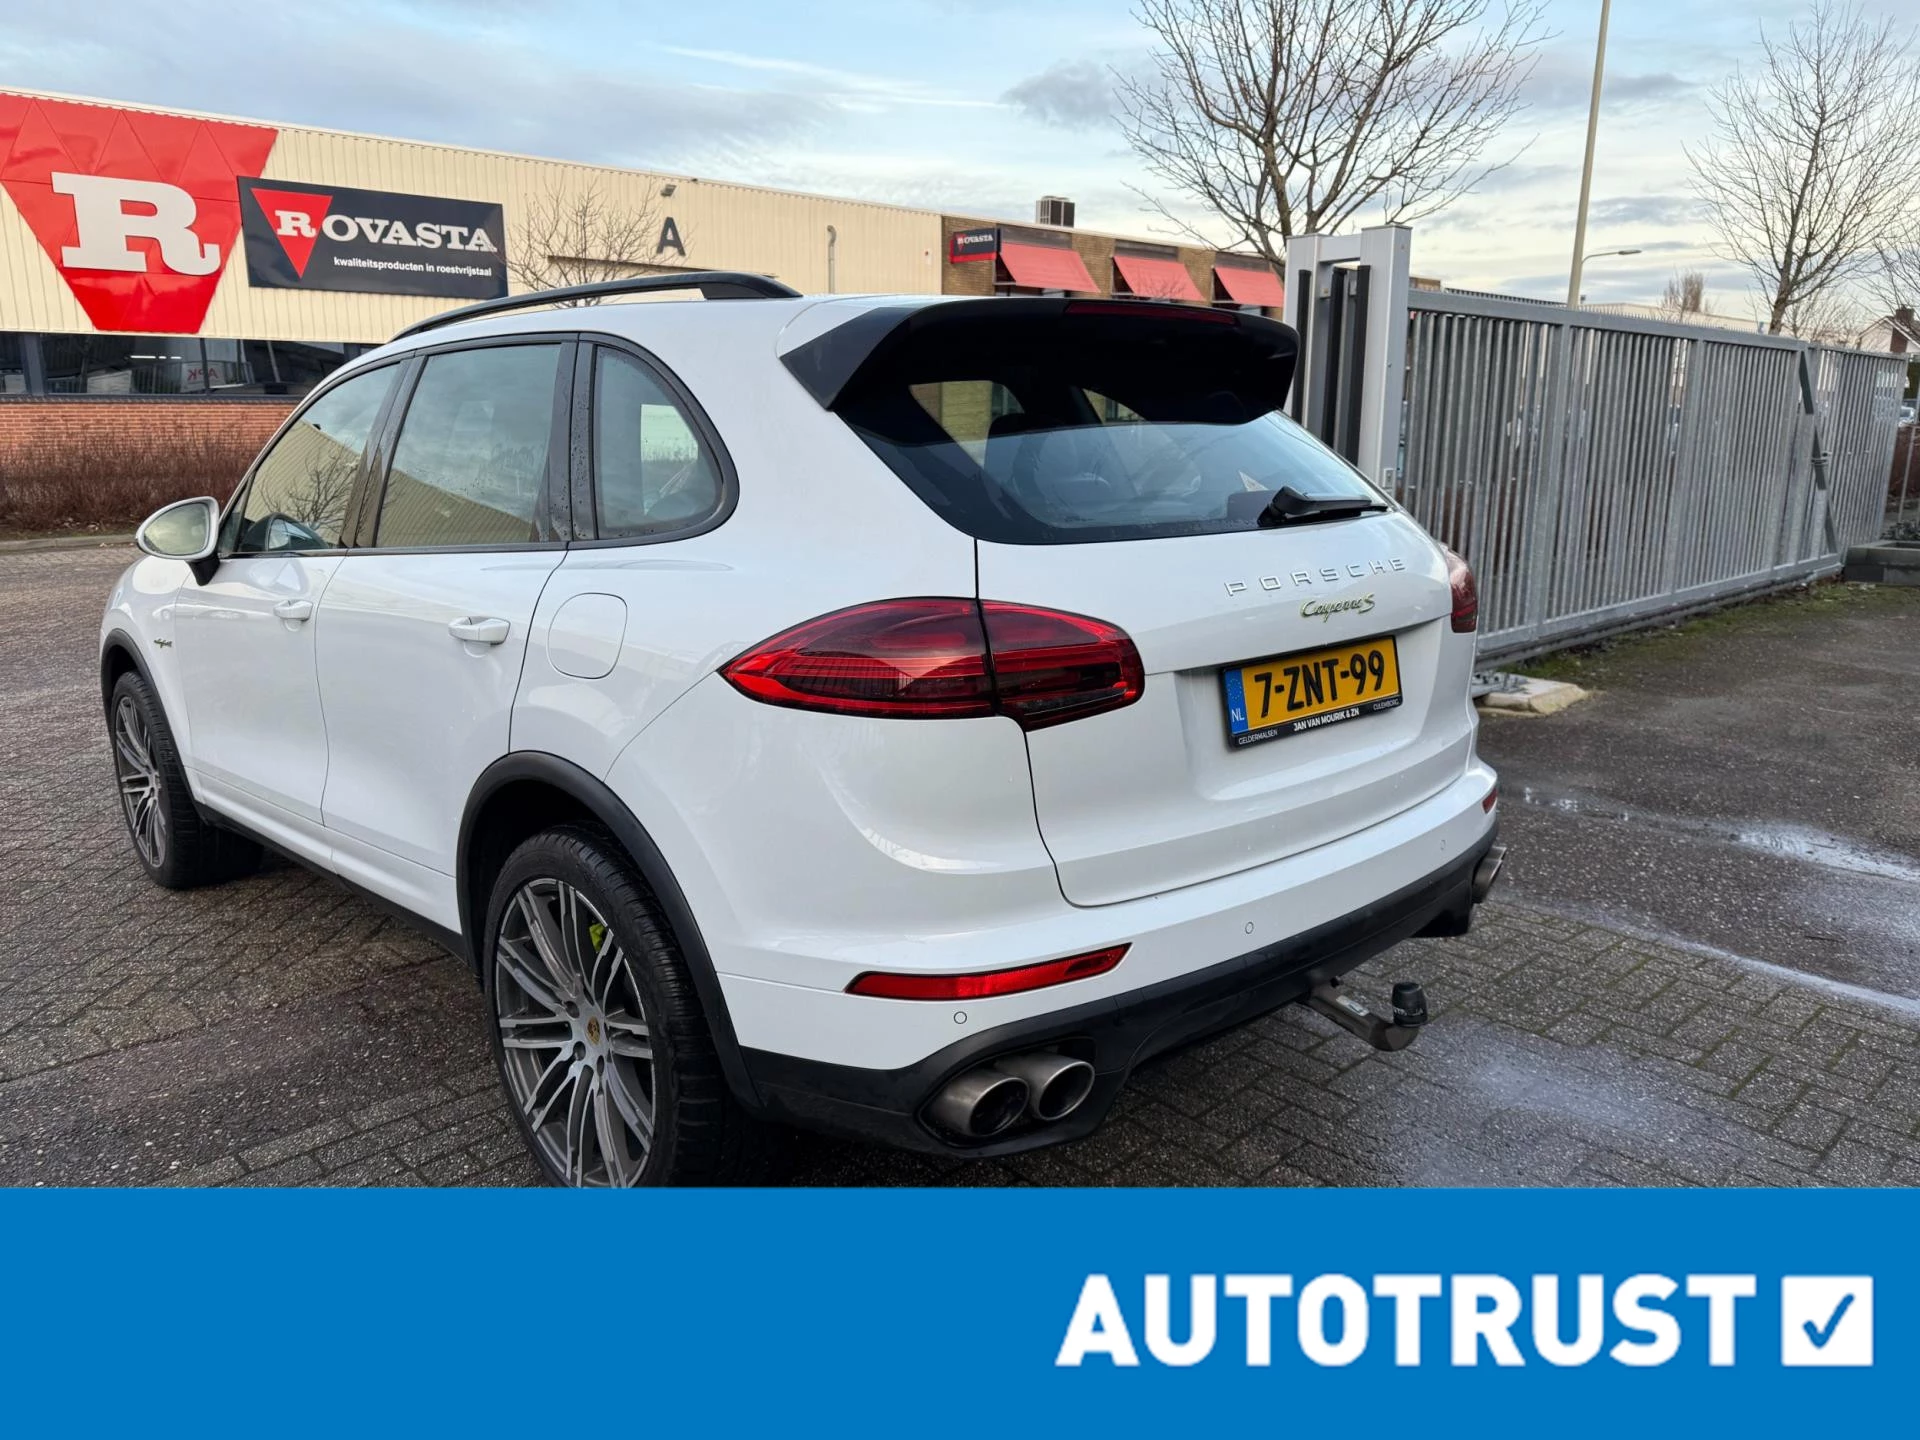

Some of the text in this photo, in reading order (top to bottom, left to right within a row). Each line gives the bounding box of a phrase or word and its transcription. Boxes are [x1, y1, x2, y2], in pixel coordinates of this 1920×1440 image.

[51, 171, 221, 276] R
[275, 209, 498, 253] ROVASTA
[656, 216, 686, 257] A
[333, 256, 492, 277] kwaliteitsproducten in roestvrijstaal
[1224, 559, 1406, 597] PORSCHE
[1358, 592, 1376, 614] S
[1254, 650, 1385, 719] 7-ZNT-99
[1231, 707, 1245, 722] NL
[1293, 720, 1307, 732] JAN
[1306, 717, 1321, 728] VAN
[1320, 711, 1346, 725] MOURIK
[1350, 707, 1360, 717] ZN
